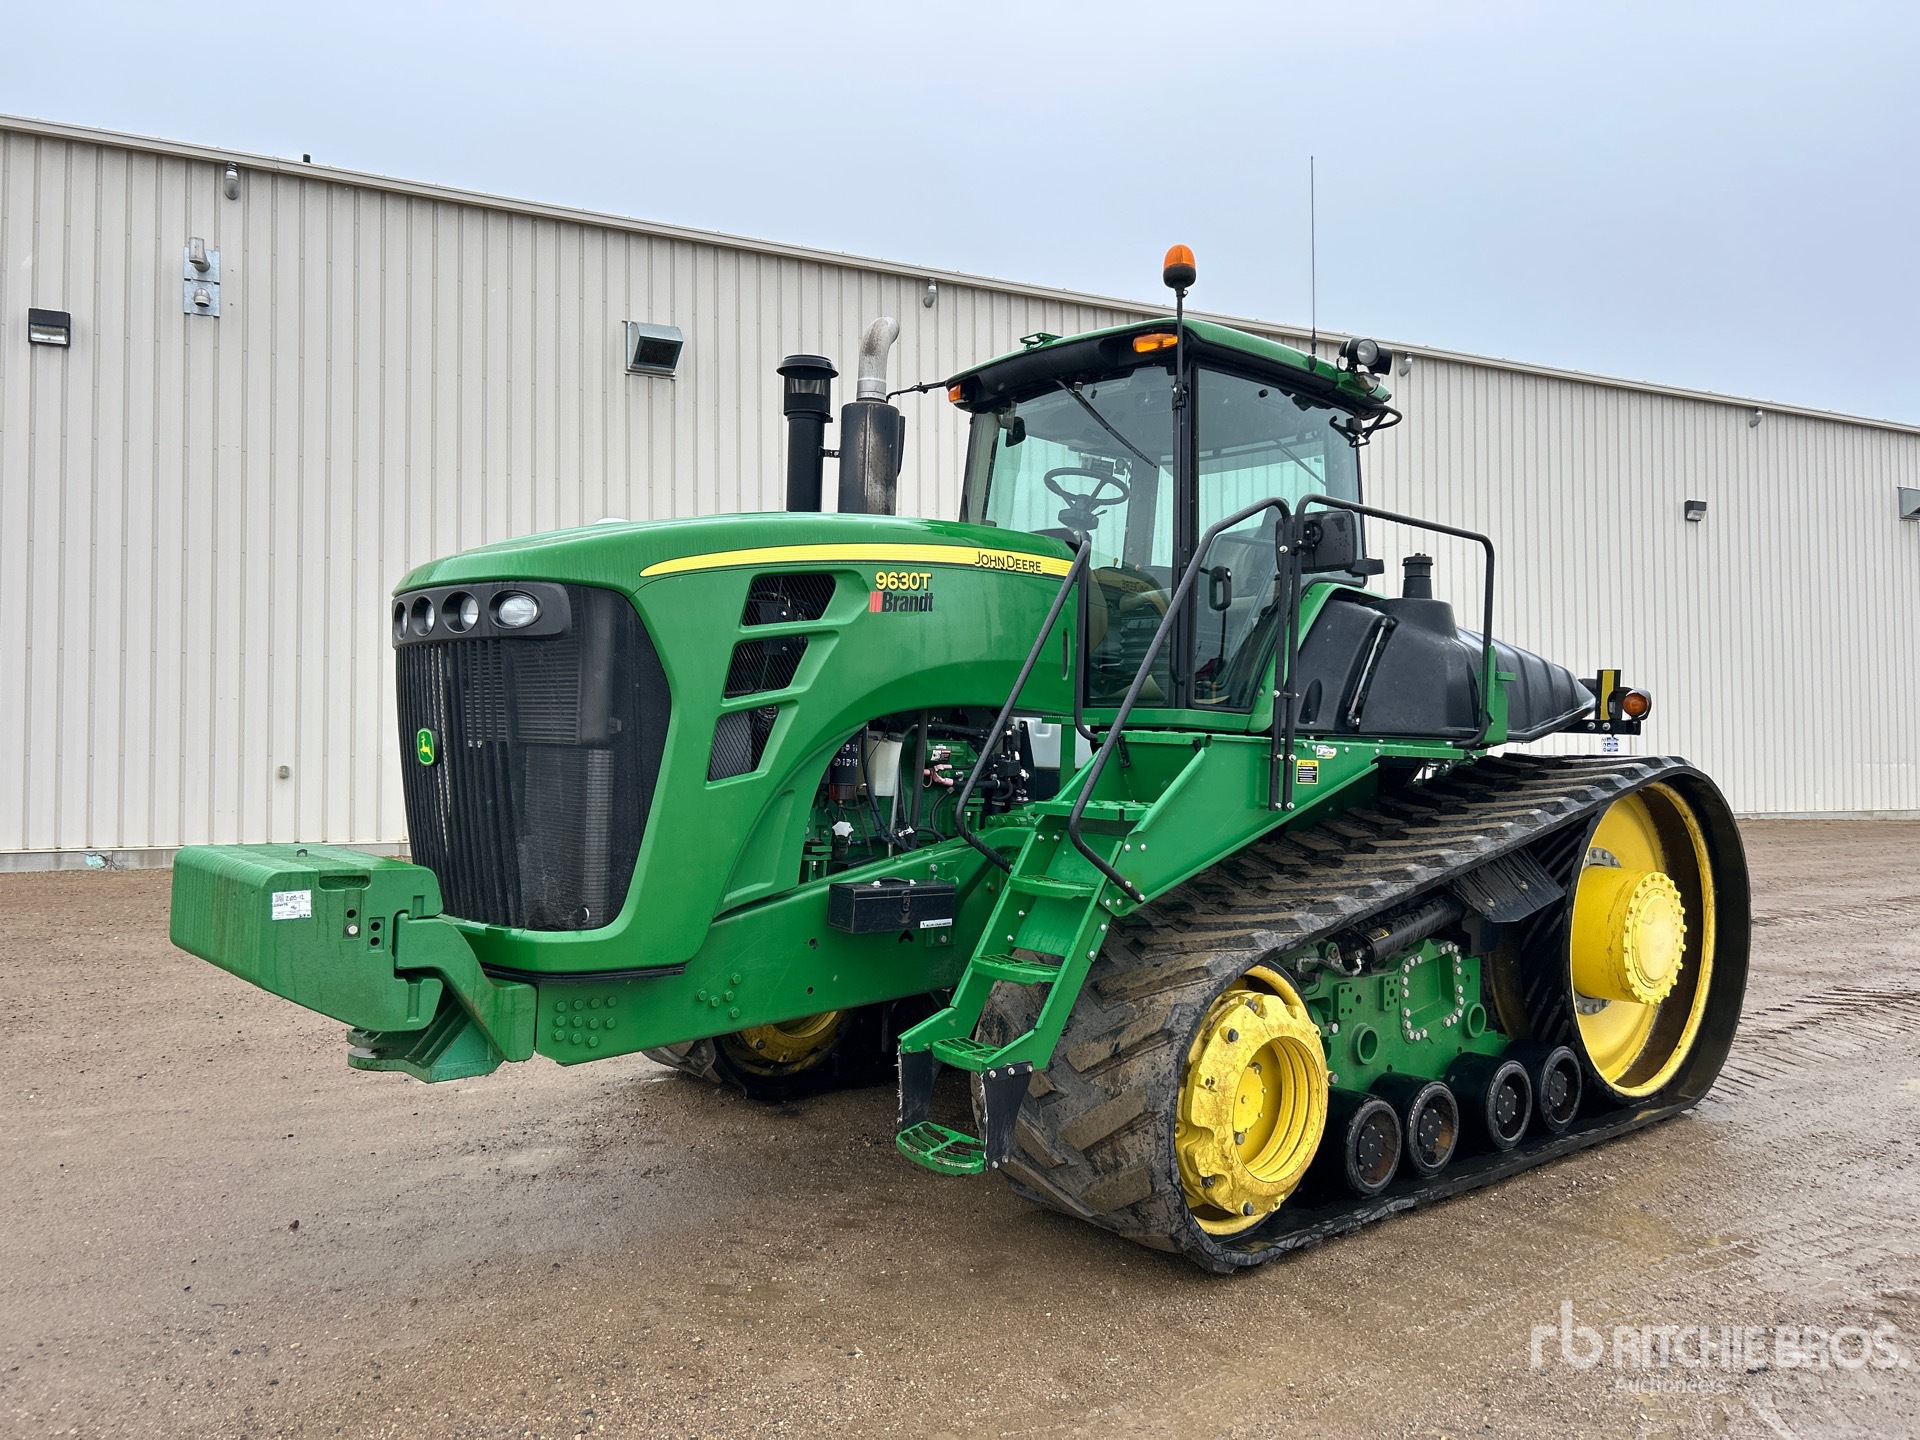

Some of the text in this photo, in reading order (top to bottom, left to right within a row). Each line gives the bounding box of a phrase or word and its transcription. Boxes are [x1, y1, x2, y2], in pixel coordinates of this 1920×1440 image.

[975, 551, 1042, 572] JOHN DEERE
[875, 571, 932, 591] 9630T
[881, 591, 934, 613] Brandt
